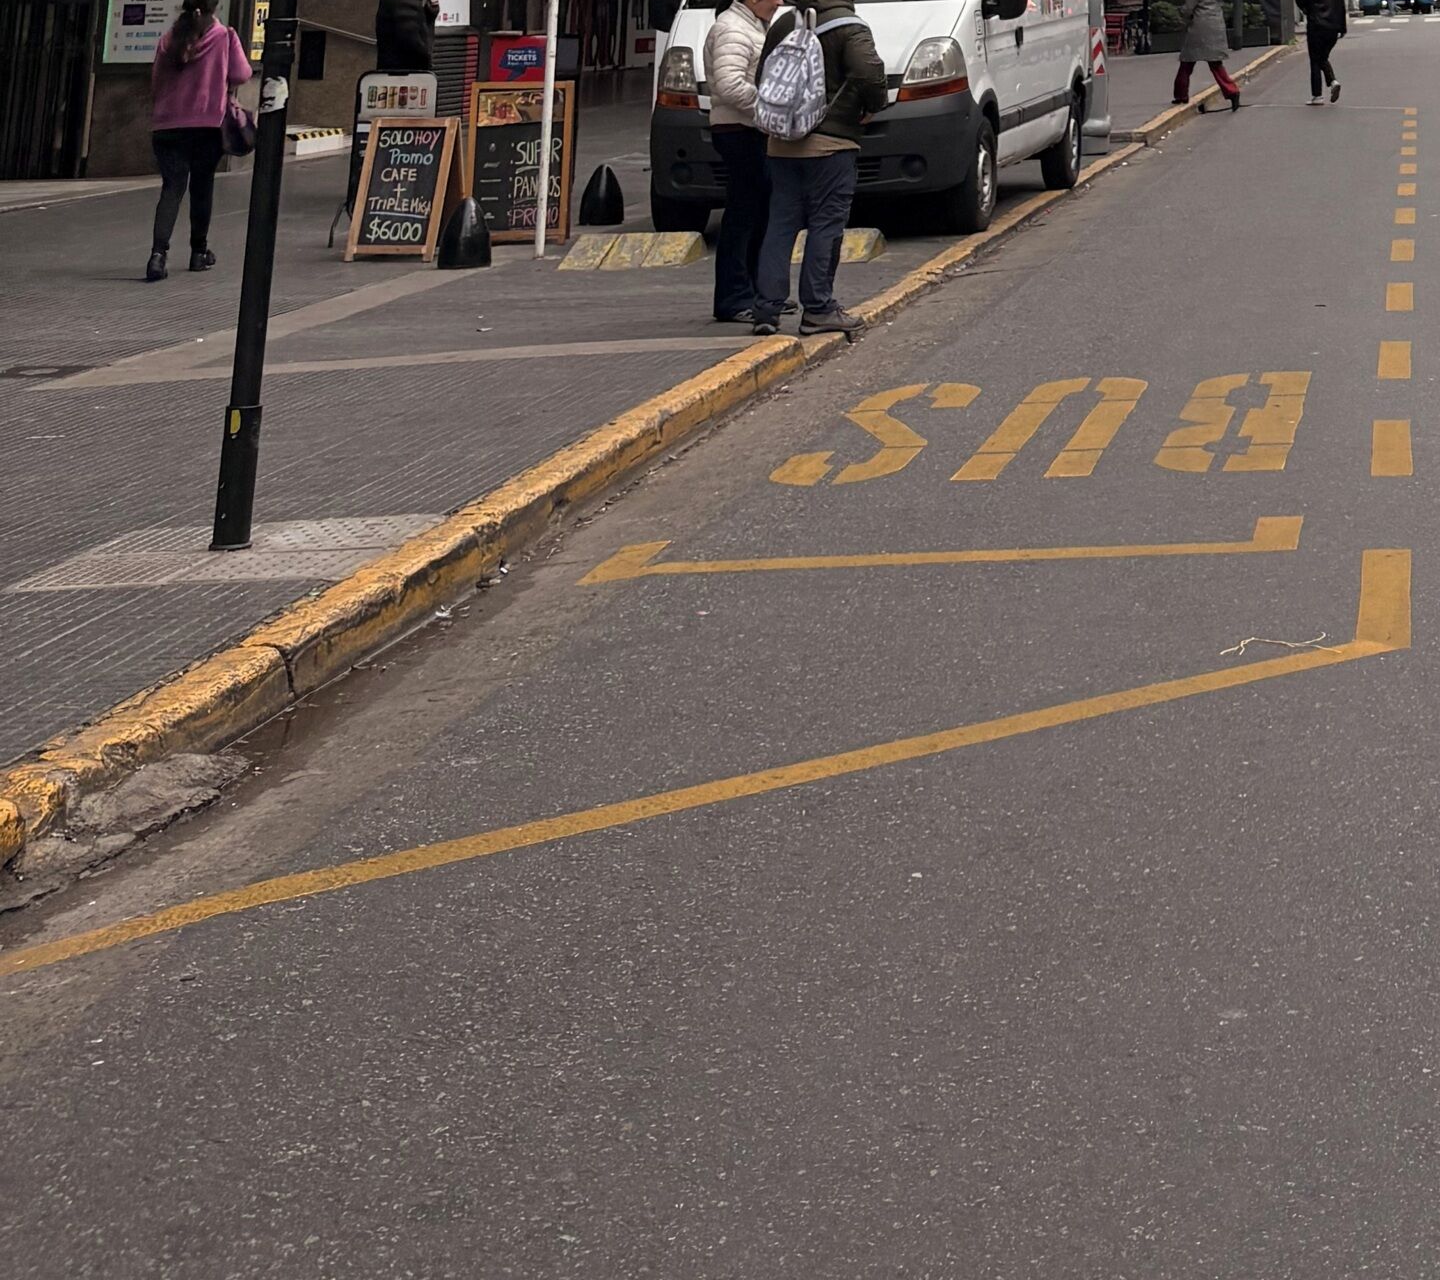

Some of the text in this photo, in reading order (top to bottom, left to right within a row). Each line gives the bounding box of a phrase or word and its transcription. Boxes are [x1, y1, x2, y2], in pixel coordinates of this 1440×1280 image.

[507, 53, 537, 62] TICKETS
[379, 129, 441, 154] SOLO HOY
[515, 138, 562, 165] SUPR
[389, 148, 434, 166] Promo
[380, 167, 417, 182] CAFE
[514, 176, 560, 198] PANOS
[512, 208, 559, 227] PROO
[366, 216, 422, 242] $6000
[769, 371, 1312, 486] BUS
